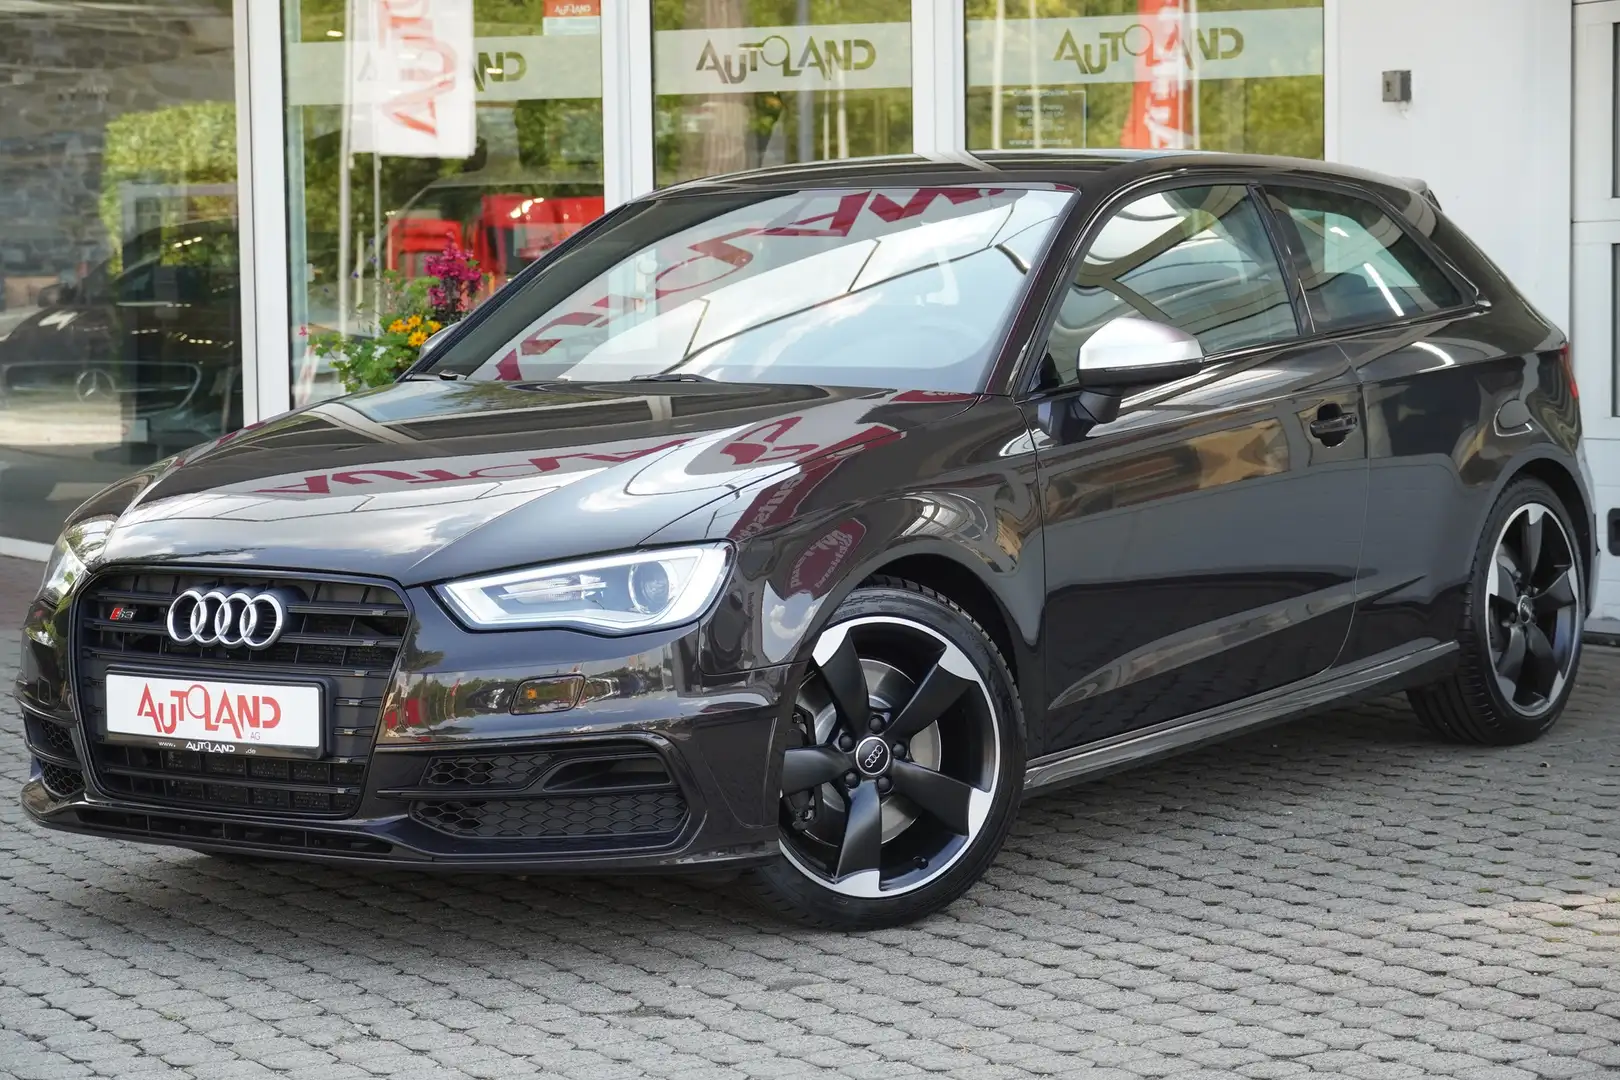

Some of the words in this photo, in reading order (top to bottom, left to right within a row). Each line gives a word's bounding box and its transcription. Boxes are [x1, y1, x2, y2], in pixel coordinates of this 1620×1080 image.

[696, 35, 876, 84] AUTOLAND
[137, 683, 281, 739] AUTOLAND
[185, 741, 236, 754] AUTOLAND
[250, 732, 261, 741] AG
